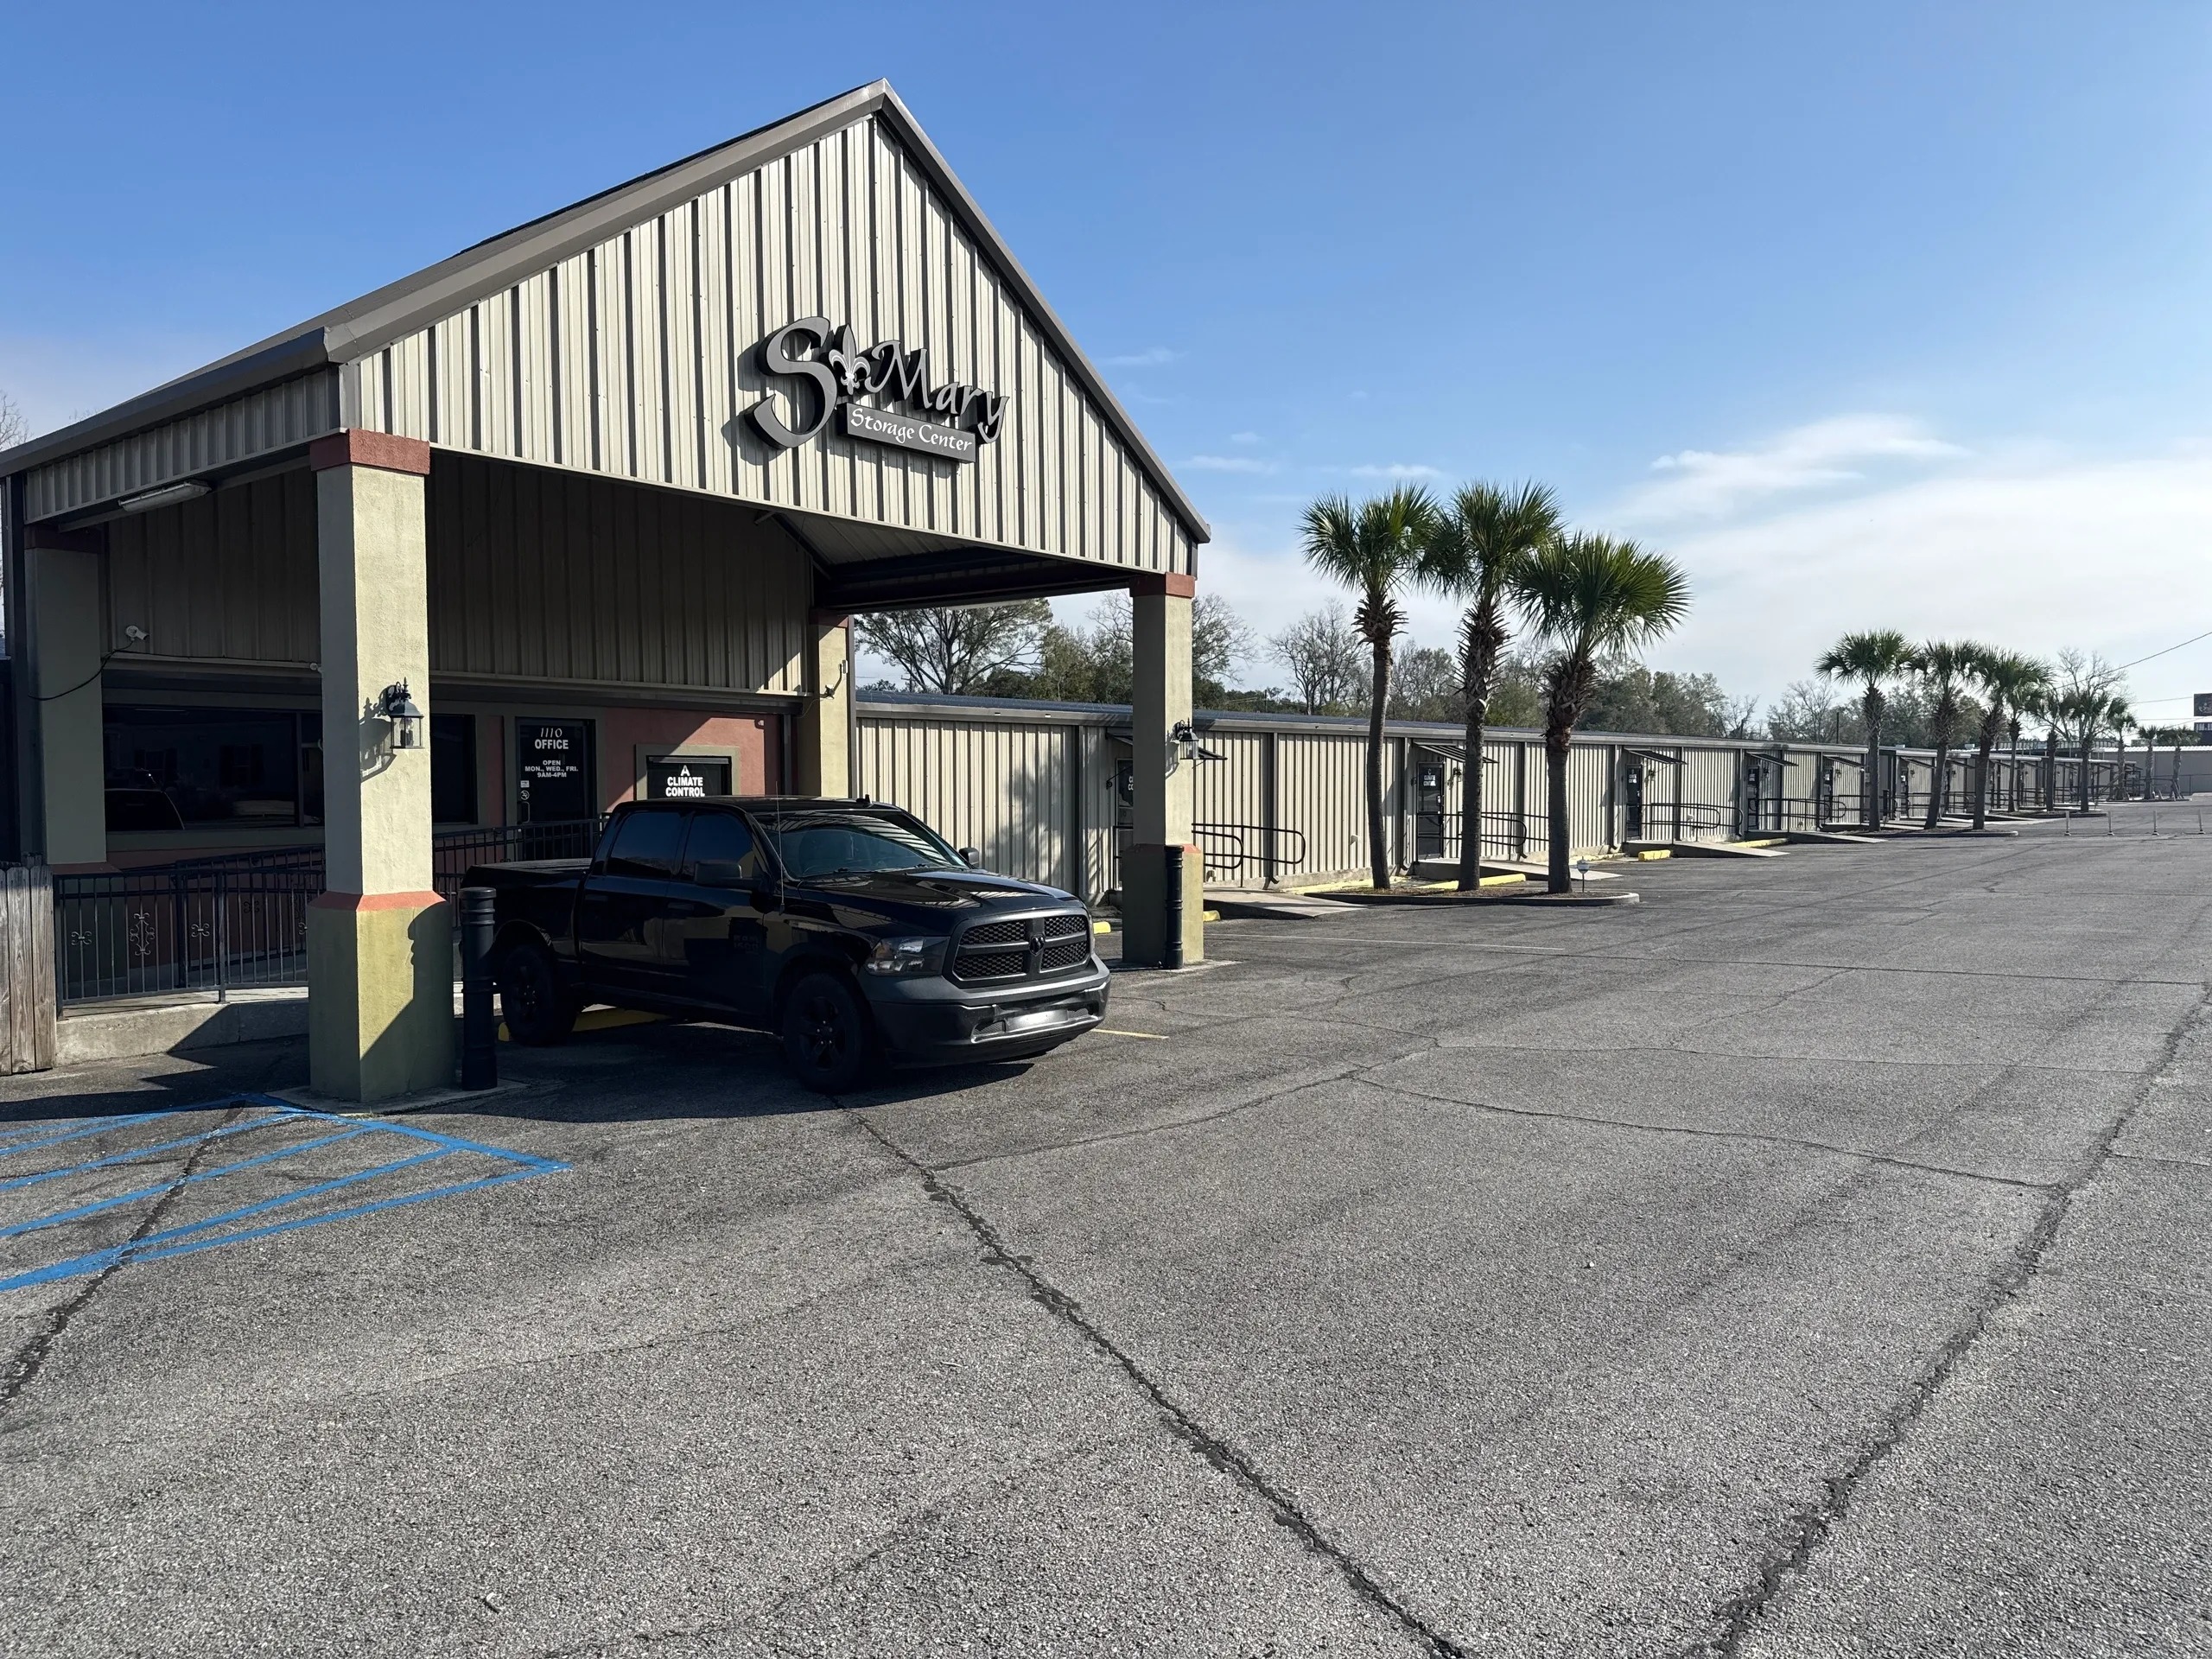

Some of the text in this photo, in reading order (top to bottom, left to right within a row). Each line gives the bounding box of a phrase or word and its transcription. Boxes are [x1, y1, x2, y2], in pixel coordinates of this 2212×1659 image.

[866, 339, 1009, 443] Mary
[850, 407, 973, 451] Storage Center
[540, 728, 563, 738] 1110
[534, 739, 569, 750] OFFICE
[680, 765, 690, 776] A
[667, 776, 703, 786] CLIMATE
[665, 786, 705, 797] CONTROL
